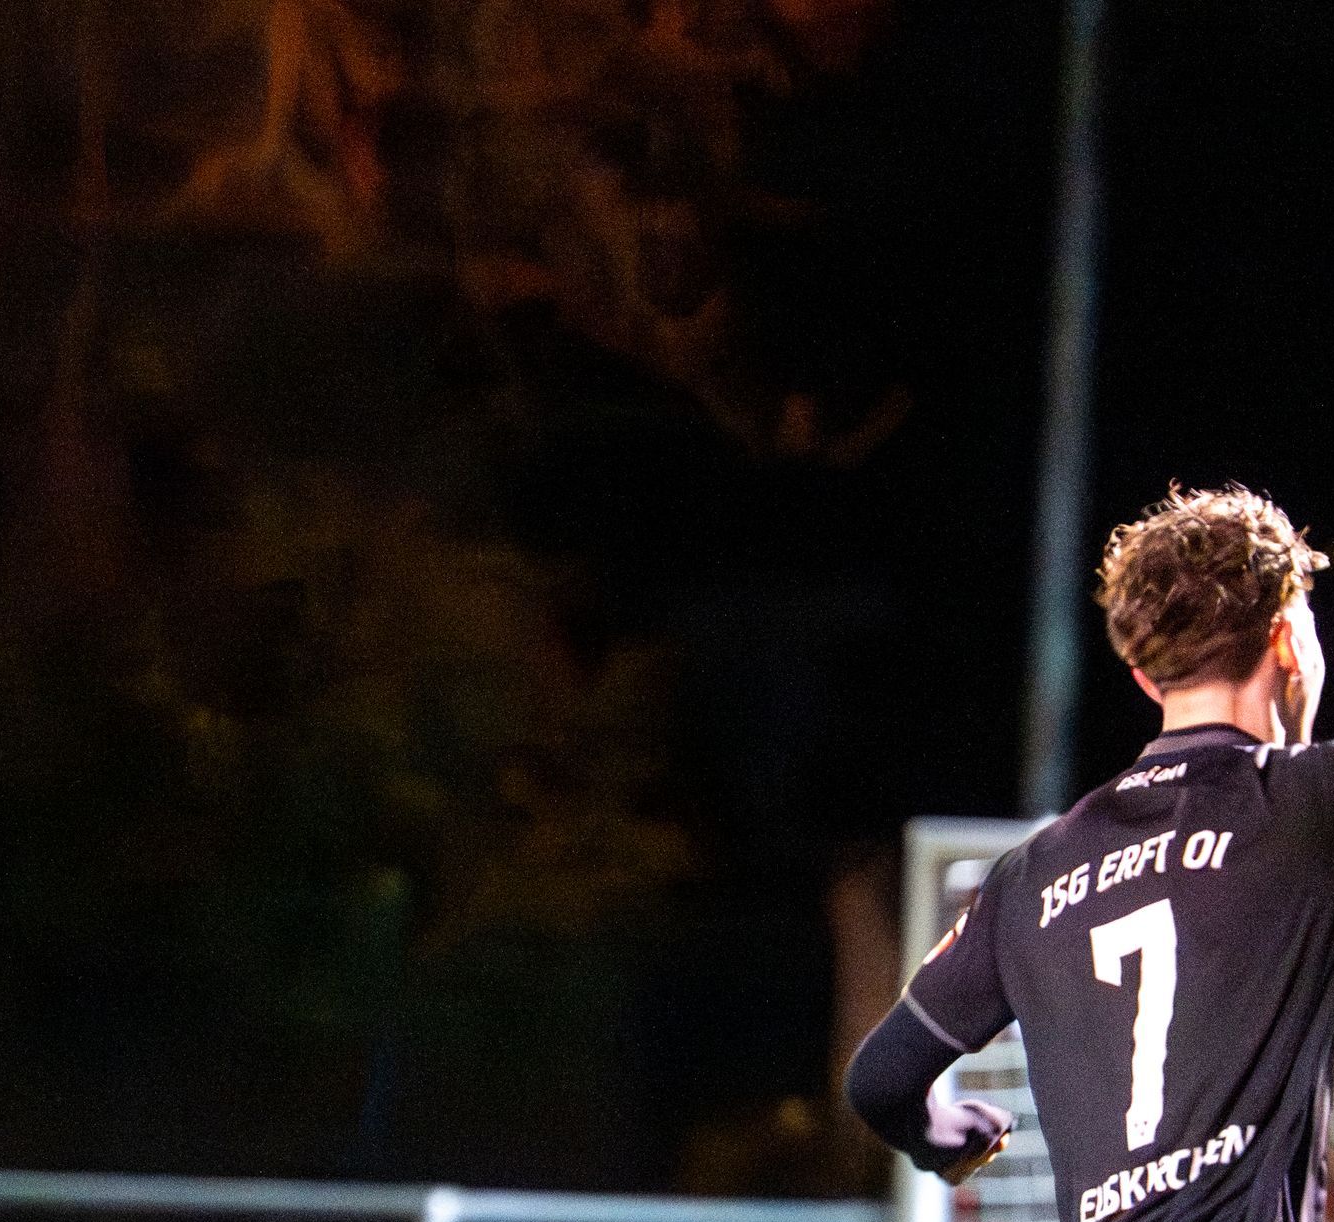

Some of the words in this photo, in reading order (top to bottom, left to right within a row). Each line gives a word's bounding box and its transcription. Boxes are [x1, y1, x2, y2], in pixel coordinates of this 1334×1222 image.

[1039, 863, 1090, 929] JSG
[1096, 830, 1176, 894] ERFT
[1089, 898, 1178, 1153] 7
